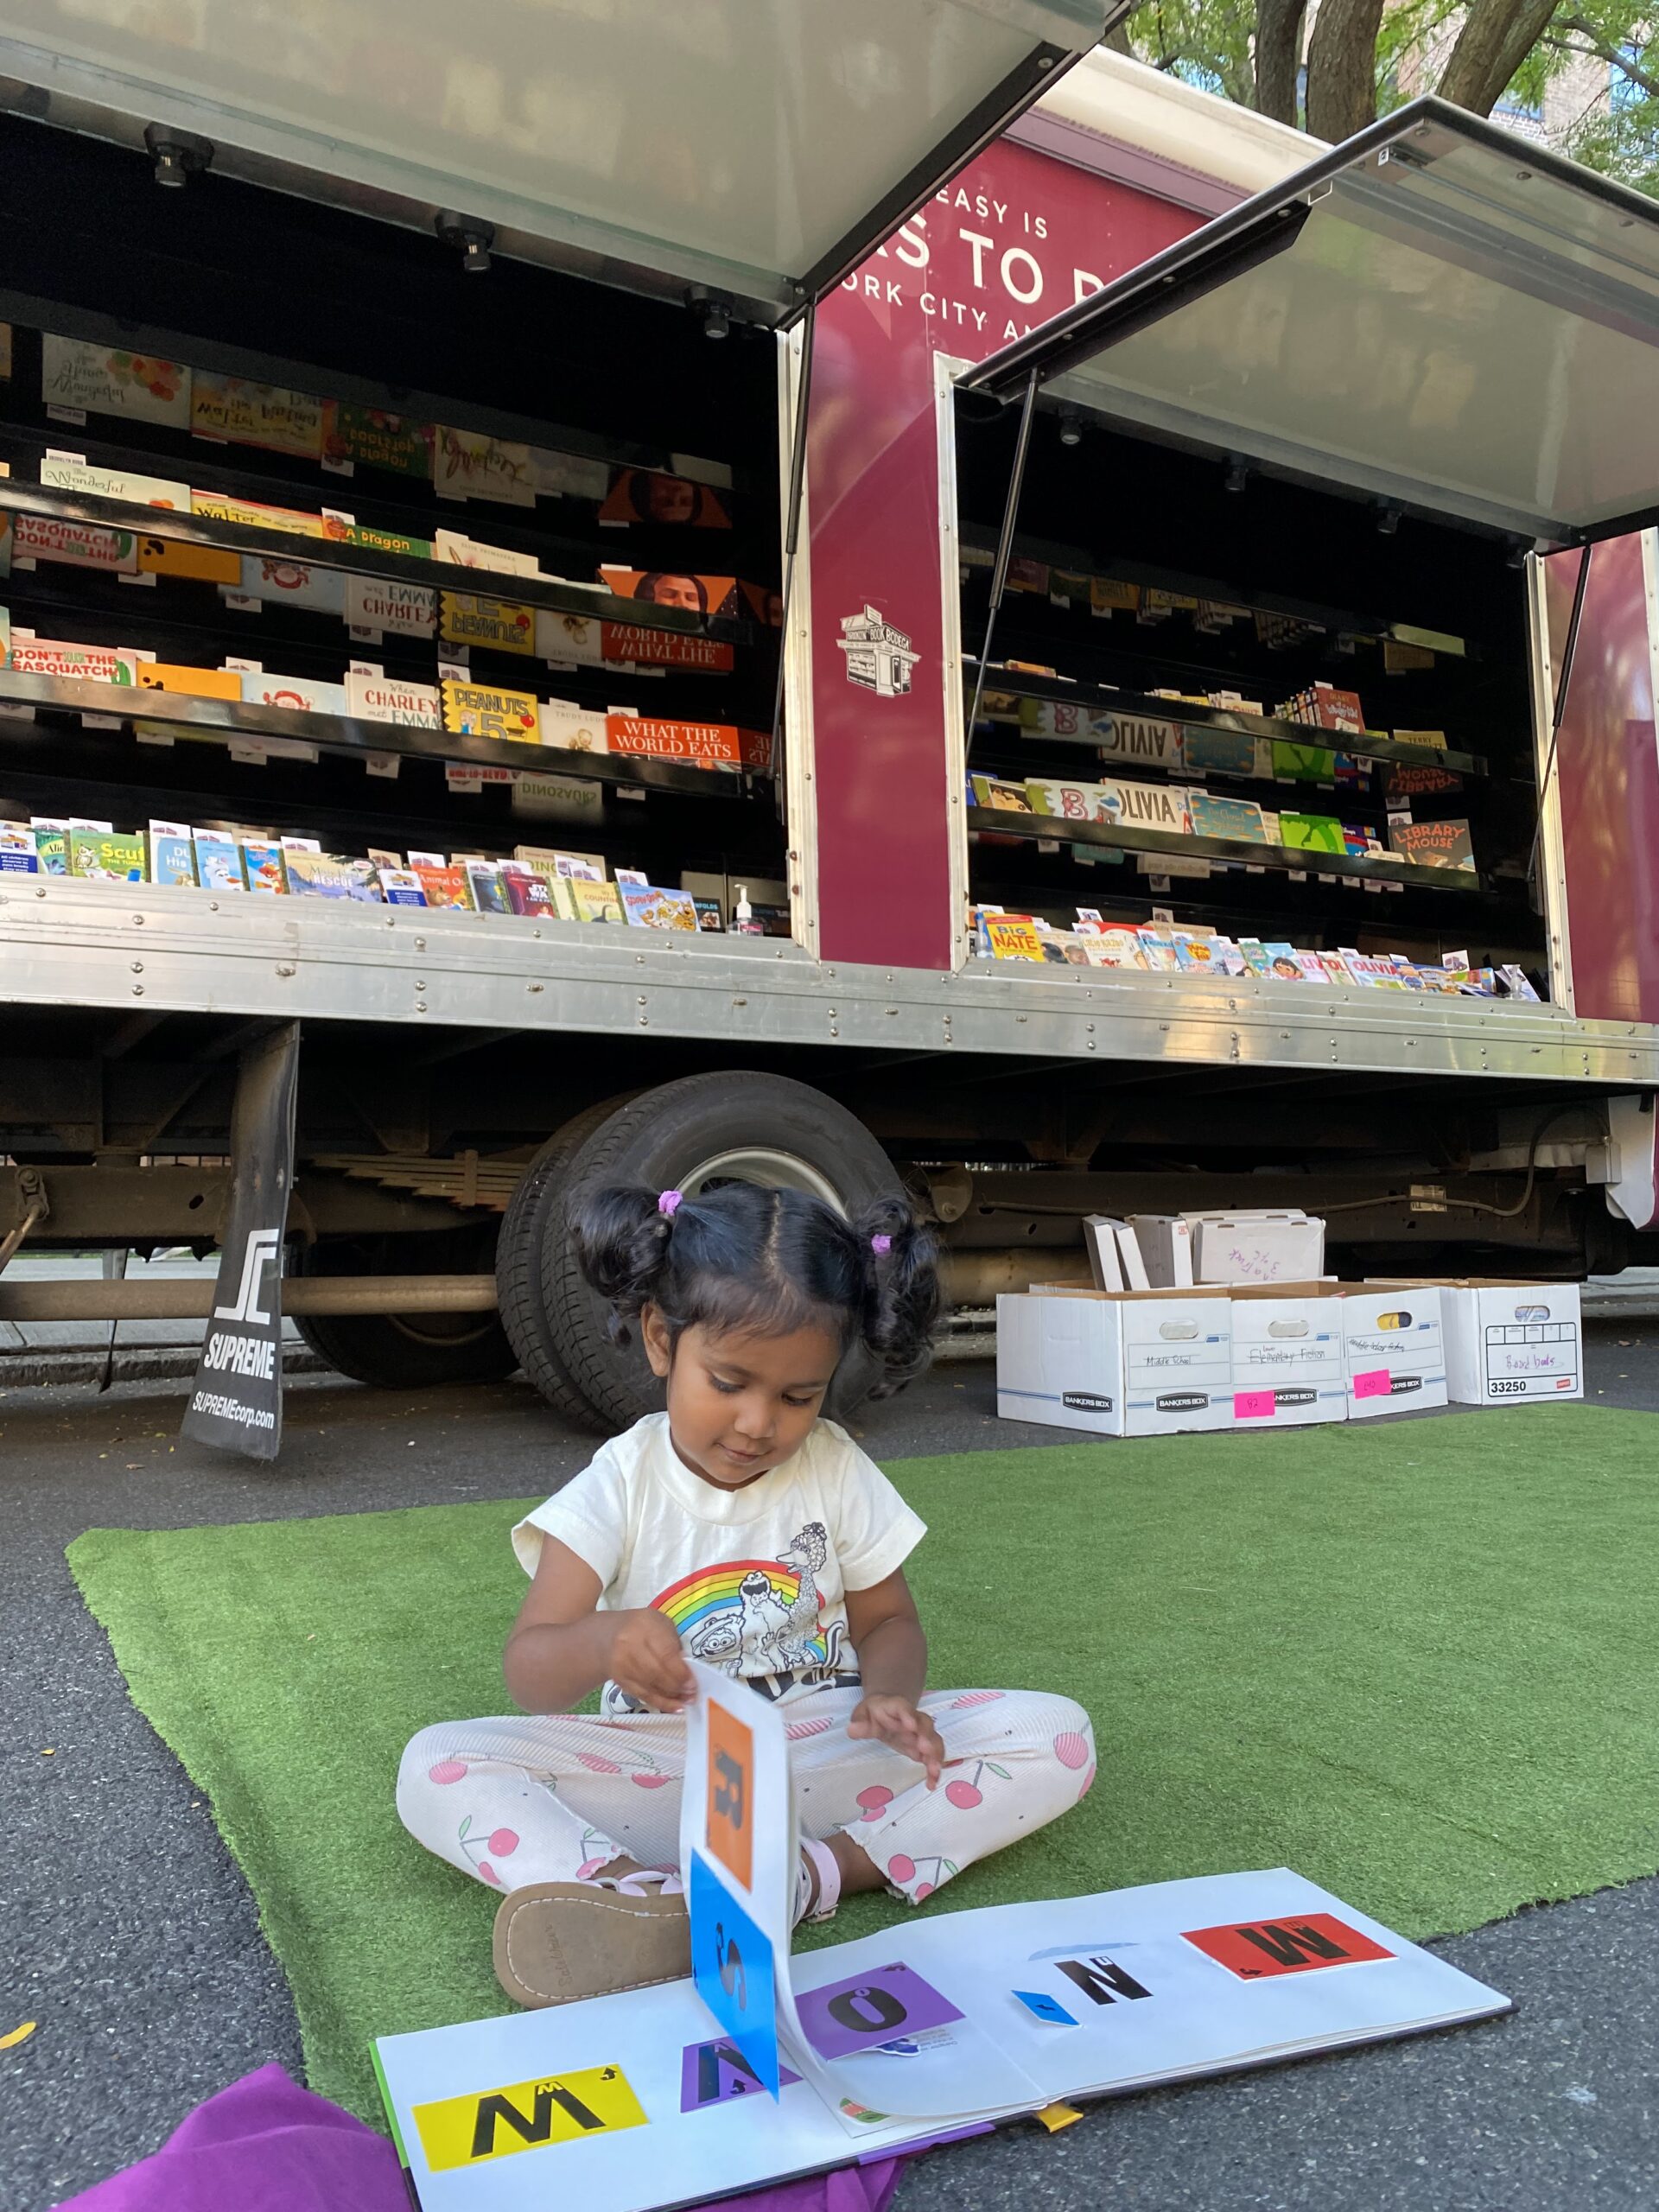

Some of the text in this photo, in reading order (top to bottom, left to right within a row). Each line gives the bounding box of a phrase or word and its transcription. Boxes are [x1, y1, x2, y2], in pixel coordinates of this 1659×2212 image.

[1024, 213, 1048, 238] IS
[959, 227, 1044, 304] TO
[919, 292, 988, 331] CITY
[46, 470, 125, 494] Wonderful
[196, 506, 257, 524] Walter
[346, 528, 410, 550] A Dragon
[886, 628, 910, 652] BODEGA
[13, 647, 62, 664] DON'T
[86, 653, 117, 666] THE
[390, 683, 416, 695] When
[365, 690, 439, 715] CHARLEY
[454, 687, 530, 716] PEANUTS
[623, 720, 722, 743] WHAT THE
[613, 733, 732, 759] WORLD EATS
[1394, 823, 1466, 844] LIBRARY
[1406, 836, 1454, 851] MOUSE
[314, 874, 354, 888] RESCUE
[420, 874, 449, 887] Animal
[992, 933, 1039, 951] NATE
[204, 1332, 276, 1380] SUPREME
[1274, 1393, 1300, 1402] NKERS
[1491, 1381, 1526, 1393] 33250
[193, 1390, 275, 1430] SUPREMEcorp.com
[1065, 1395, 1109, 1409] BANKERS BOX
[1159, 1395, 1206, 1408] BANKERS BOX
[1053, 1955, 1154, 2005] N
